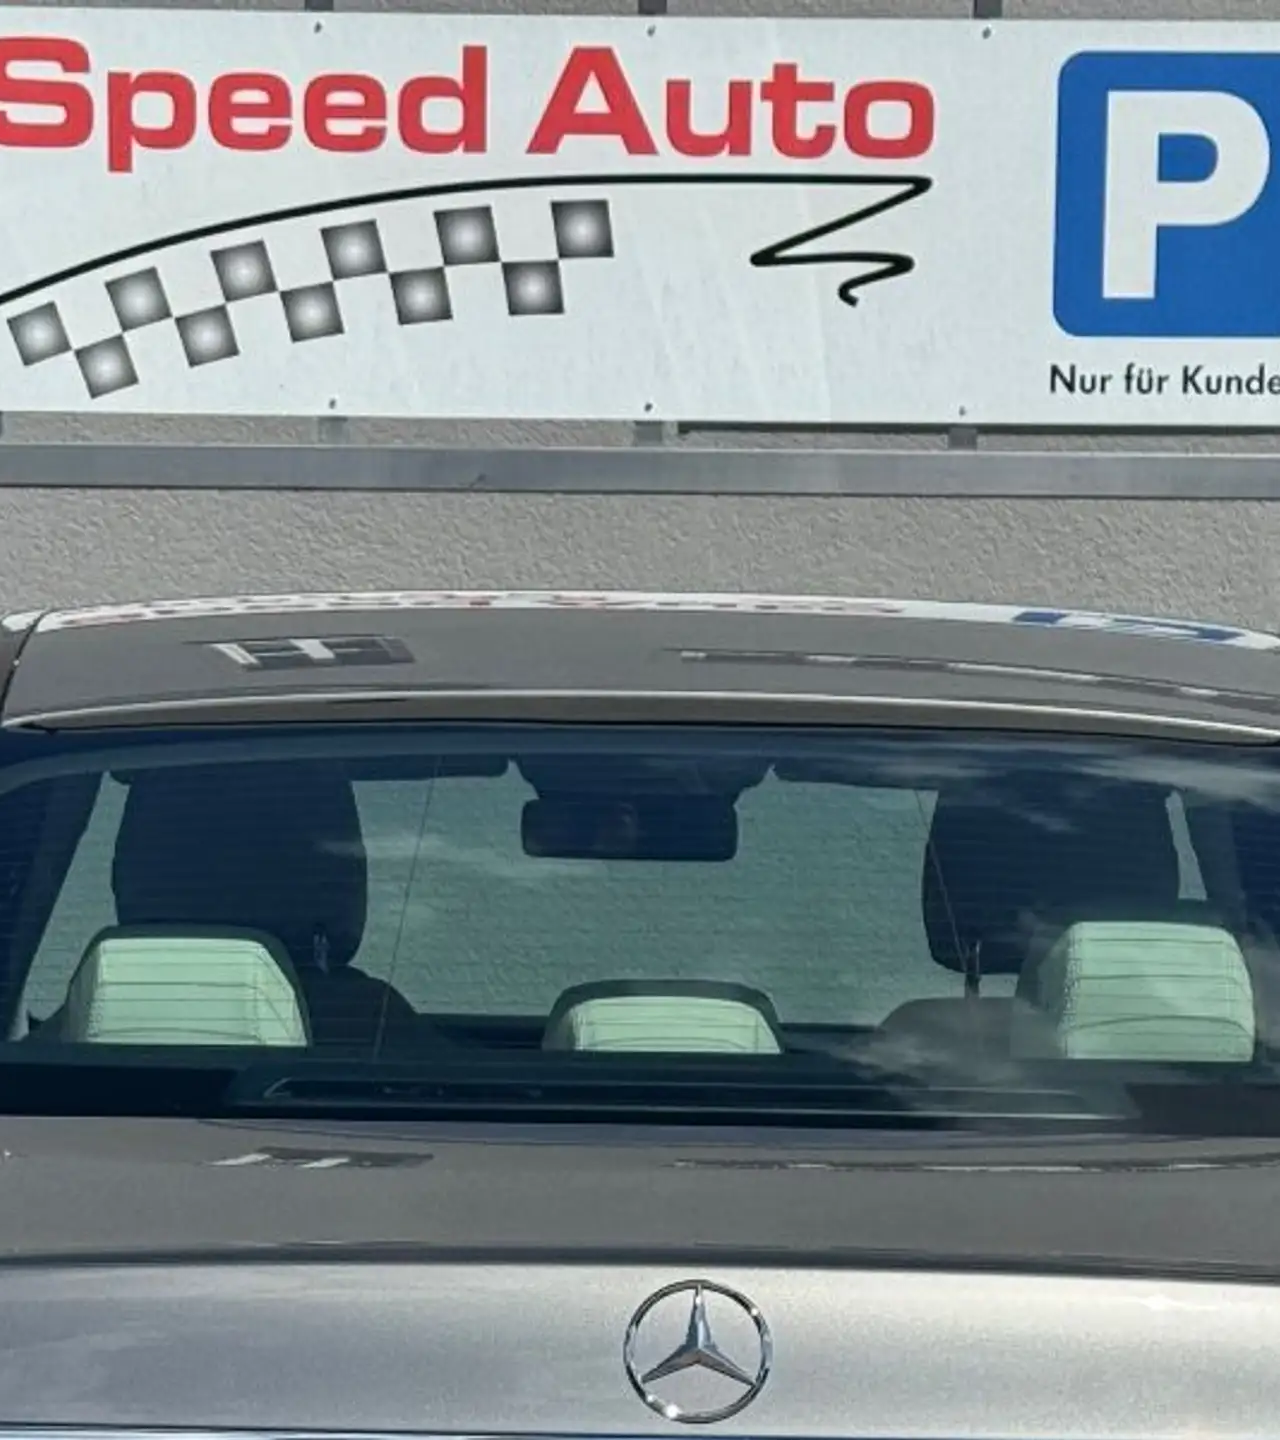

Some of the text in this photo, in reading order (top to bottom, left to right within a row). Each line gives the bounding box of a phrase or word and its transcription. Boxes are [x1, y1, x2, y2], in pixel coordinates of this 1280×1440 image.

[527, 46, 935, 160] Auto
[1102, 91, 1270, 299] P
[1049, 363, 1113, 395] Nur
[1124, 362, 1169, 395] für
